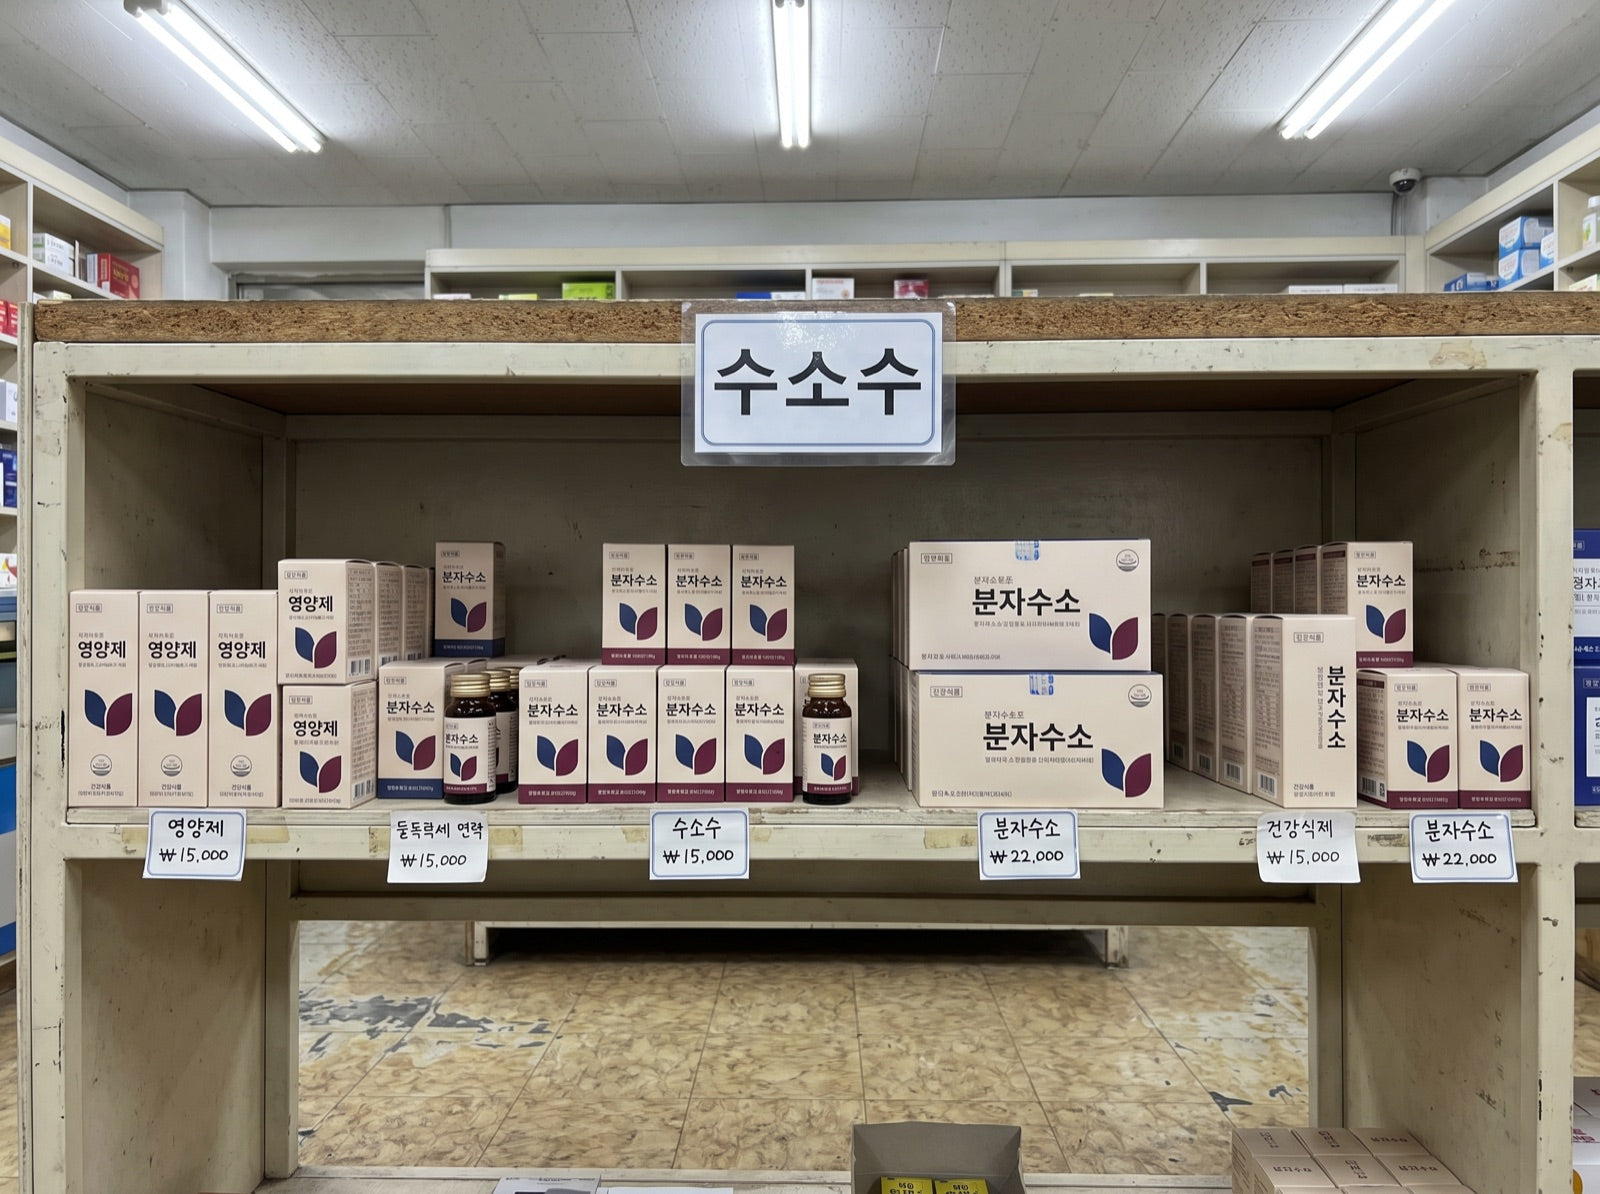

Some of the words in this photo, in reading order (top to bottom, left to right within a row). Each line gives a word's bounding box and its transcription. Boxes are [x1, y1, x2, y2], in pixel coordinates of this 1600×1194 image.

[714, 348, 921, 415] 수소수
[442, 570, 486, 583] 분자수소
[610, 573, 658, 586] 분자수소
[675, 574, 723, 587] 분자수소
[740, 575, 787, 588] 분자수소
[1355, 574, 1406, 587] 분자수소
[288, 595, 333, 612] 영양제
[972, 587, 1081, 616] 분자수소
[77, 640, 126, 658] 영양제
[148, 640, 197, 659] 영양제
[218, 640, 266, 659] 영양제
[386, 700, 435, 714] 분자수소
[527, 703, 579, 717] 분자수소
[596, 703, 647, 716] 분자수소
[665, 702, 717, 716] 분자수소
[734, 702, 785, 716] 분자수소
[1327, 665, 1347, 748] 분자수소
[1469, 707, 1523, 722] 분자수소
[1396, 708, 1449, 722] 분자수소
[293, 720, 338, 737] 영양제
[982, 722, 1094, 751] 분자수소
[445, 733, 479, 744] 분자수소
[813, 733, 847, 744] 분자수소
[168, 817, 224, 838] 영양제
[671, 816, 722, 839] 수소수
[993, 817, 1061, 839] 분자수소
[1266, 819, 1333, 838] 건강식제
[1424, 819, 1494, 842] 분자수소
